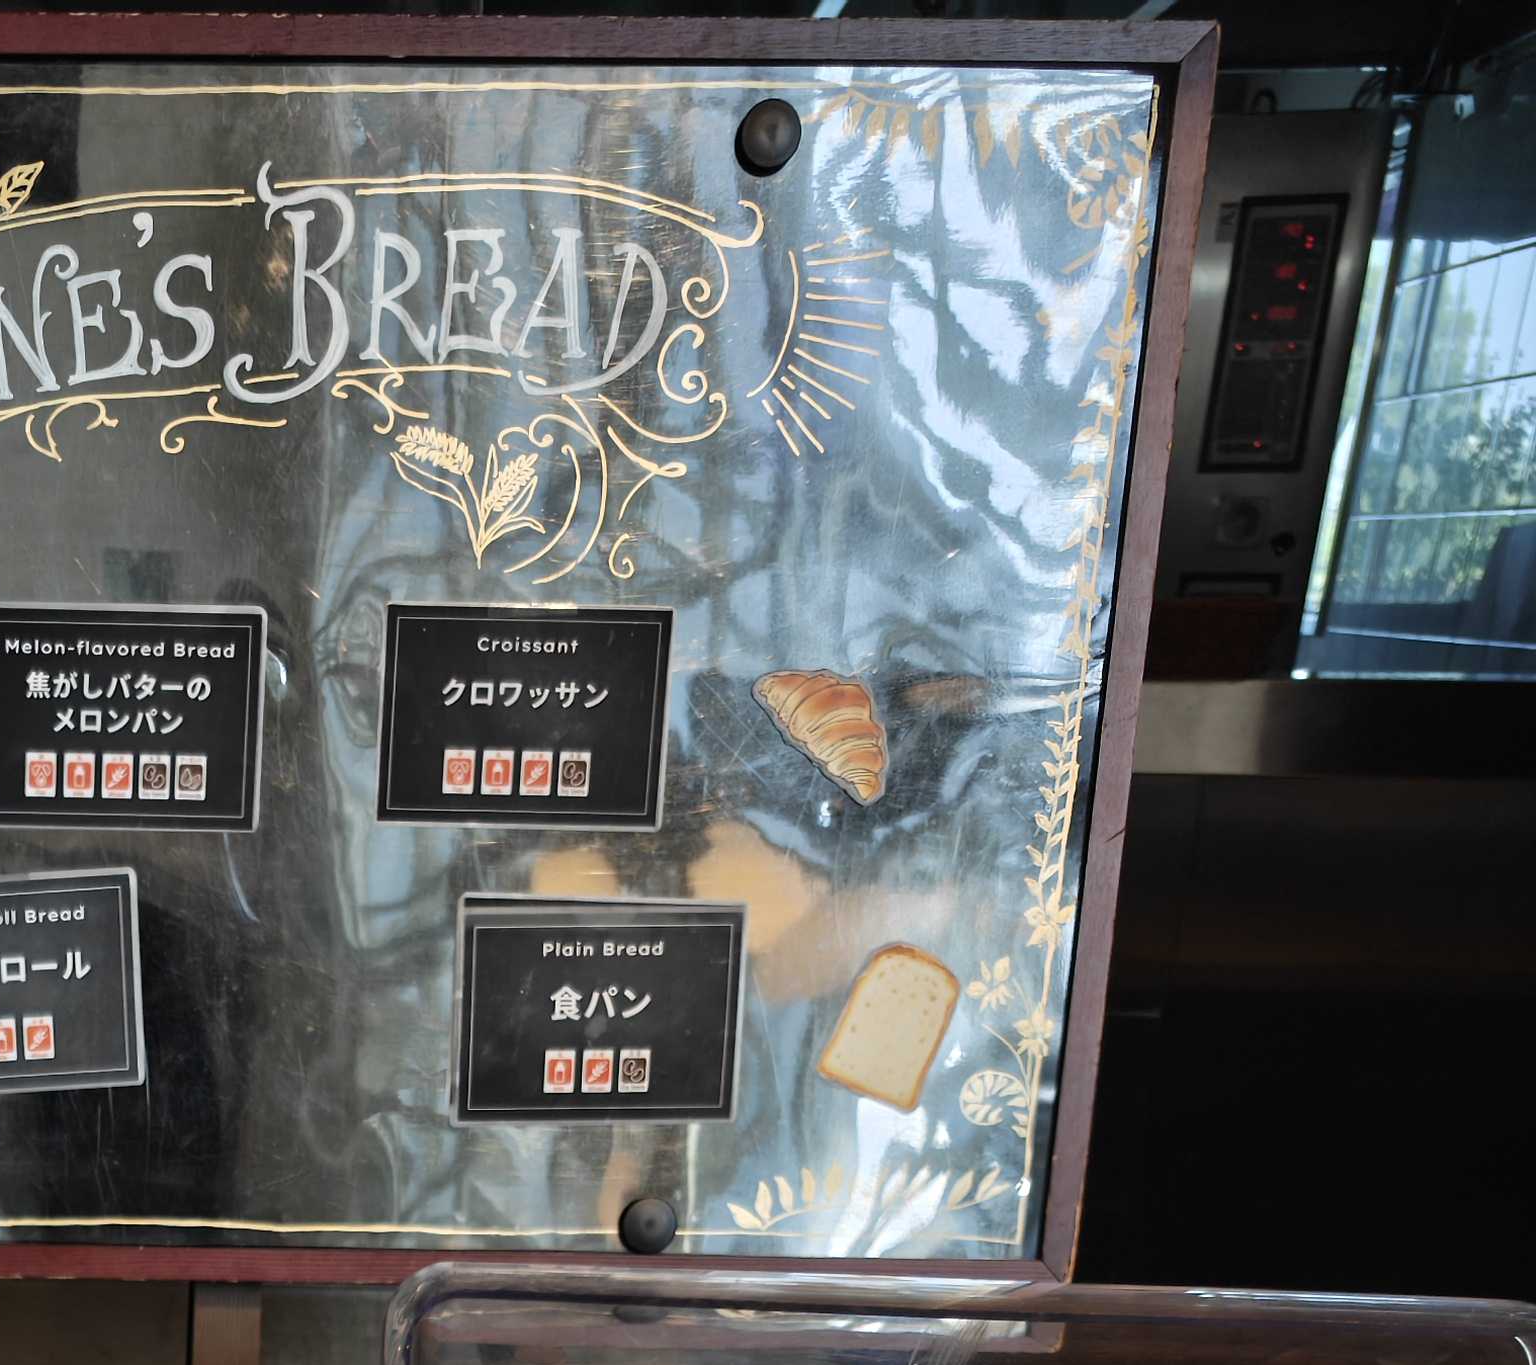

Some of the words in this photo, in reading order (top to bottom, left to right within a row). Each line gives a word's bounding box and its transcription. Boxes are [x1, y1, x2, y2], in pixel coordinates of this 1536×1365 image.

[222, 160, 668, 403] BREAD
[4, 638, 165, 659] Melon-flavored
[173, 642, 236, 659] Bread
[477, 636, 580, 655] Croissant
[25, 671, 212, 701] 焦がしバターの
[441, 678, 609, 709] クロワッサン
[52, 707, 184, 734] メロンパン
[24, 904, 86, 925] Bread
[542, 941, 595, 958] Plain
[602, 940, 665, 957] Bread
[550, 985, 652, 1021] 食パン
